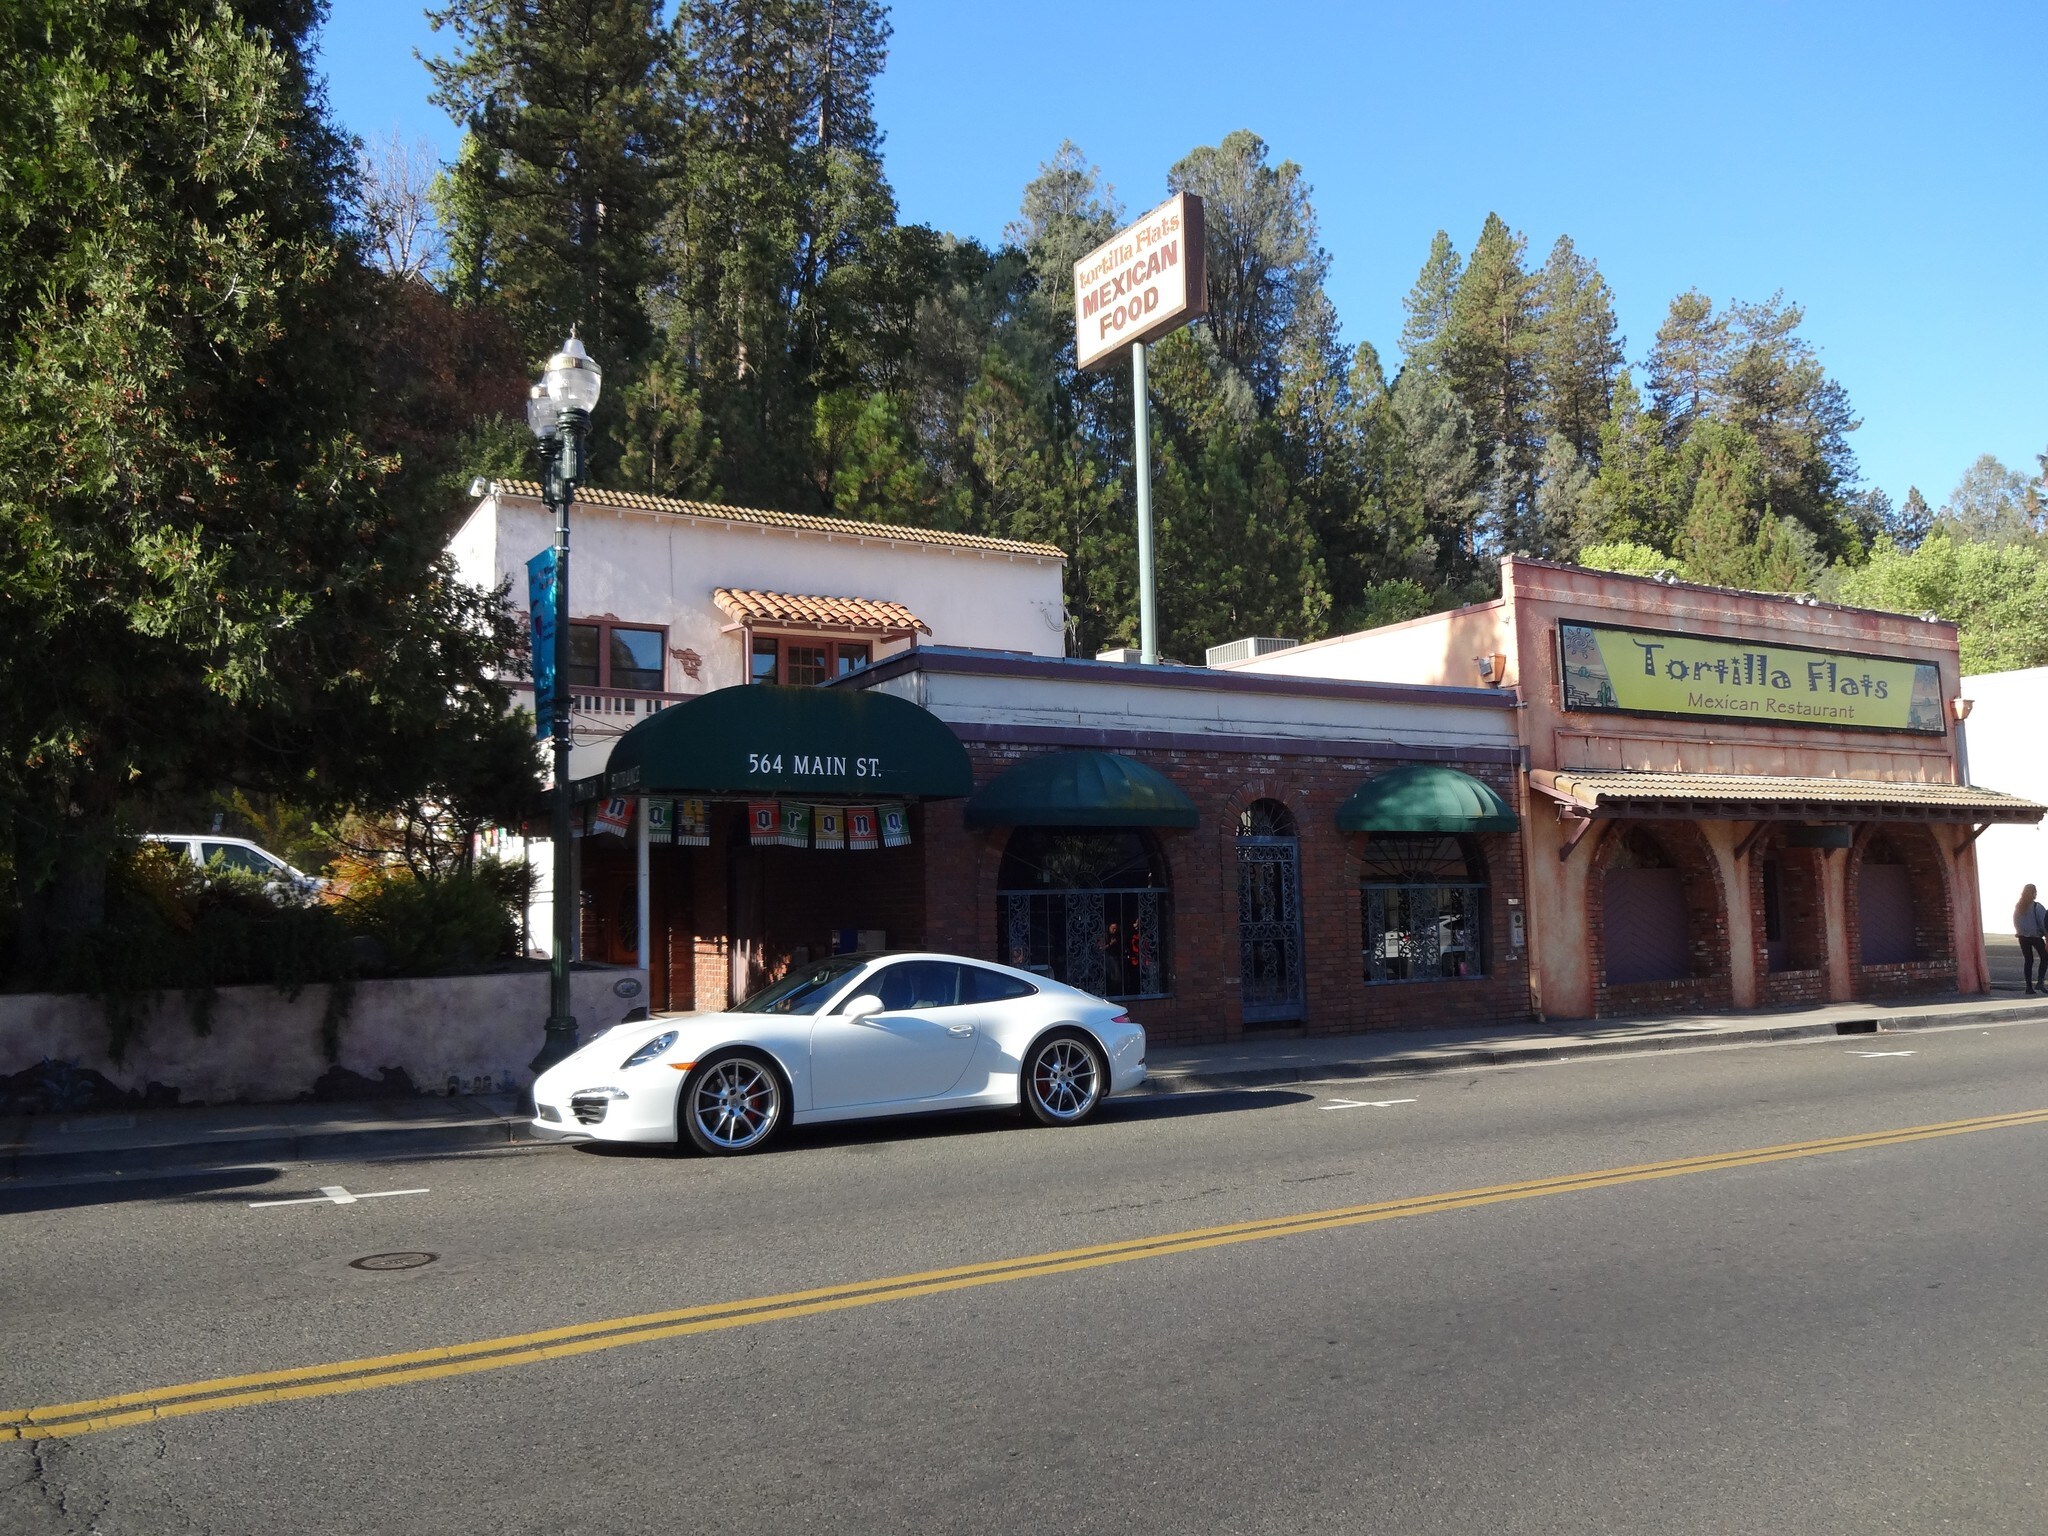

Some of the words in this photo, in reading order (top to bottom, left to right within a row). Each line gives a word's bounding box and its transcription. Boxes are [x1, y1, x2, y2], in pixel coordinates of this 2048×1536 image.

[1079, 244, 1134, 289] tortilla
[1136, 213, 1180, 254] Flats
[1082, 239, 1178, 319] MEXICAN
[1099, 286, 1159, 341] FOOD
[1632, 638, 1792, 690] Tortilla
[1806, 658, 1889, 700] Flats
[1687, 691, 1760, 713] Mexican
[1766, 697, 1855, 720] Restaurant
[749, 753, 783, 774] 564
[793, 755, 847, 776] MAIN
[856, 757, 882, 778] ST.
